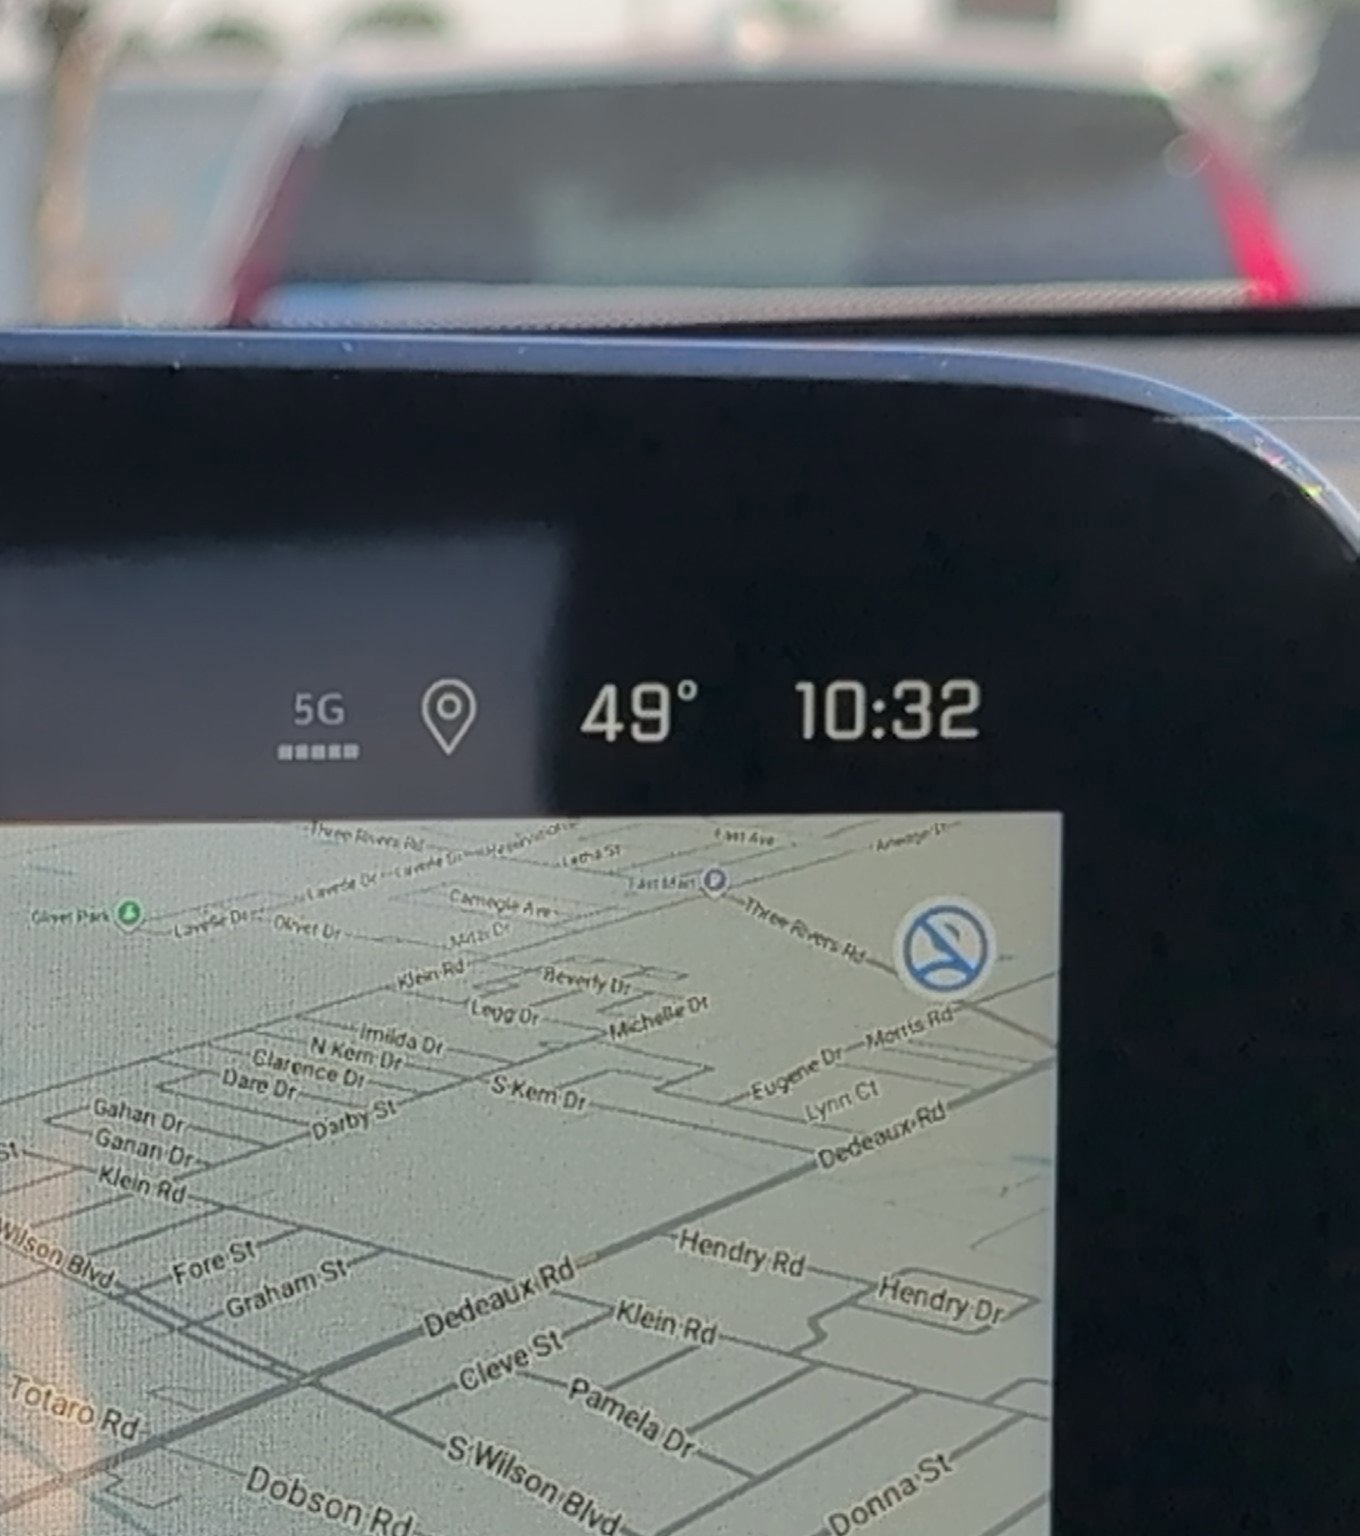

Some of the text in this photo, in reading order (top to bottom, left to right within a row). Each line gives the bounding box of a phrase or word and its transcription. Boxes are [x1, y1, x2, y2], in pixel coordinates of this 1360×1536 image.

[294, 694, 345, 726] 5G
[580, 681, 697, 743] 49°
[795, 681, 980, 740] 10:32
[790, 916, 839, 954] Rivers
[841, 939, 867, 963] Rd
[440, 956, 467, 978] Rd
[519, 1007, 541, 1028] Dr
[608, 994, 710, 1041] Michelle Dr
[864, 1004, 957, 1050] Morris Rd
[418, 1033, 445, 1055] Dr
[222, 1066, 298, 1101] Dare Dr
[252, 1047, 366, 1089] Clarence Dr
[491, 1071, 508, 1093] S
[563, 1090, 588, 1112] Dr
[749, 1046, 845, 1102] Eugene Dr
[93, 1099, 186, 1136] Gahan Dr
[311, 1094, 399, 1145] Darby St
[804, 1078, 881, 1125] Lynn Ct
[167, 1142, 196, 1170] Dr
[816, 1099, 949, 1170] Dedeaux Rd
[98, 1163, 187, 1203] Klein Rd
[66, 1252, 116, 1291] Blvd
[172, 1240, 257, 1286] Fore St
[679, 1226, 807, 1279] Hendry Rd
[224, 1257, 350, 1319] Graham St
[422, 1255, 577, 1338] Dedeaux Rd
[879, 1274, 1006, 1324] Hendry Dr
[615, 1300, 718, 1346] Klein Rd
[457, 1330, 565, 1392] Cleve St
[9, 1374, 140, 1441] Totaro Rd
[569, 1376, 696, 1460] Pamela Dr
[447, 1434, 469, 1461] S
[473, 1445, 561, 1503] Wilson
[917, 1449, 955, 1488] St
[244, 1467, 364, 1527] Dobson
